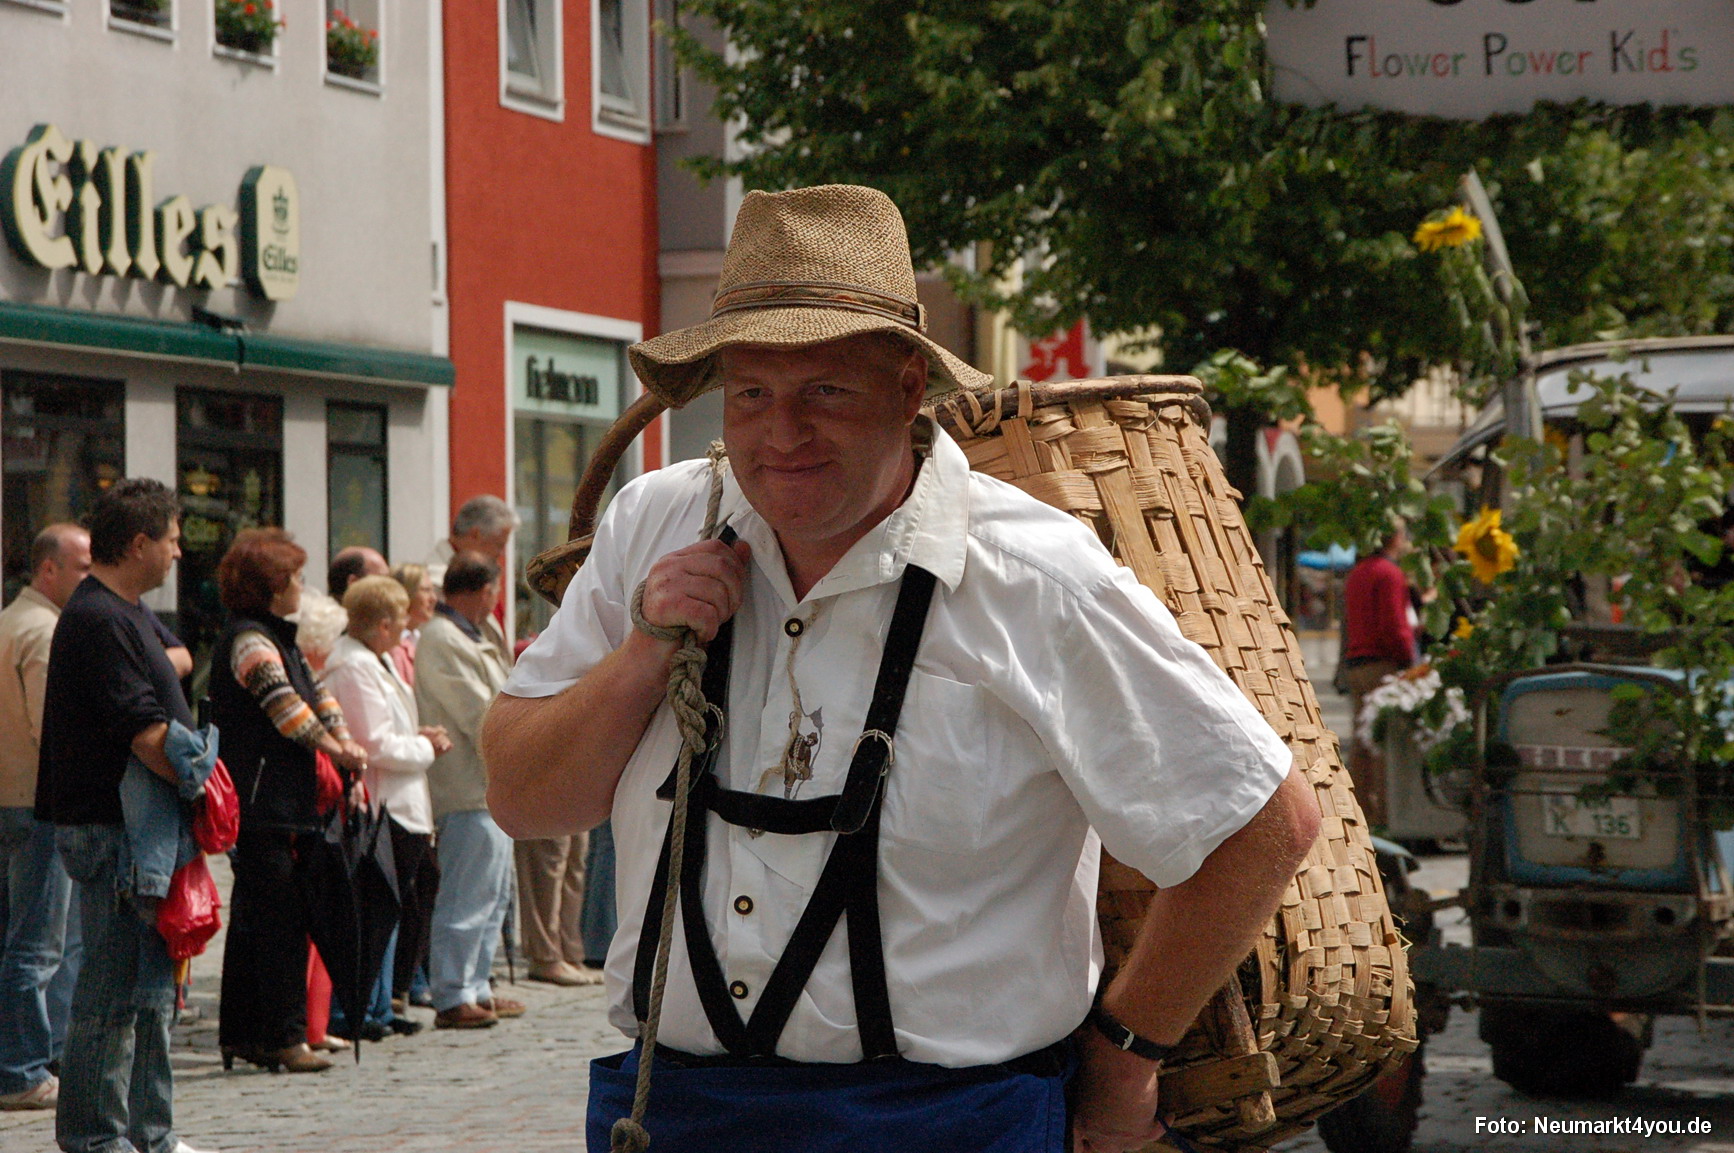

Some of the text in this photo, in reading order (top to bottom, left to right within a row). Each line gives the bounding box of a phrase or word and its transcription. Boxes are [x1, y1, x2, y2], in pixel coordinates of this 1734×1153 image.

[1344, 34, 1466, 79] Flower
[1482, 32, 1593, 77] Power
[5, 123, 239, 291] Eilles
